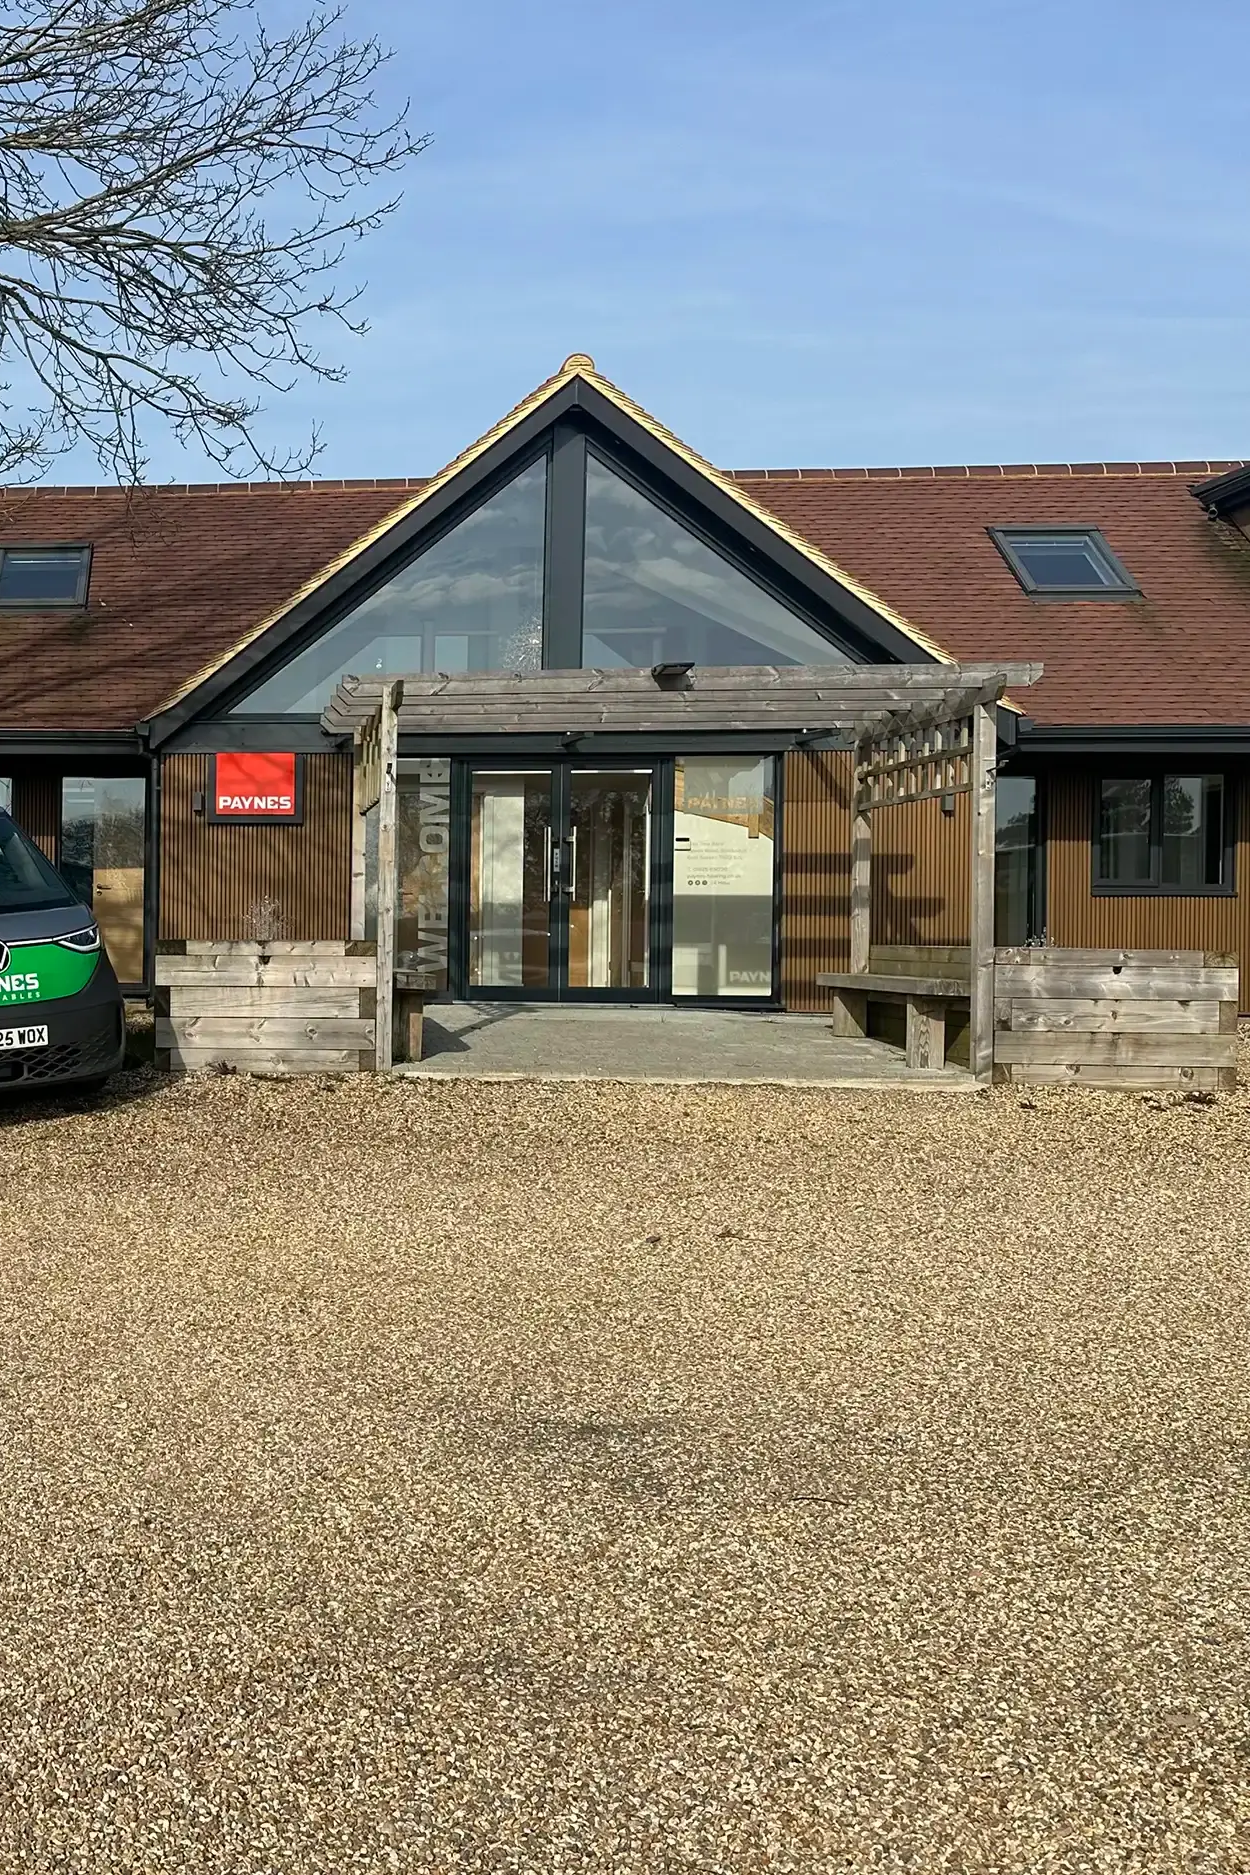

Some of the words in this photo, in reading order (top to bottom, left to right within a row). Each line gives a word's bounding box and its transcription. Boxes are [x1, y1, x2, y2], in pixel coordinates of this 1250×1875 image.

[218, 796, 292, 810] PAYNES
[417, 758, 450, 972] WEOME
[17, 1027, 46, 1045] WOX
